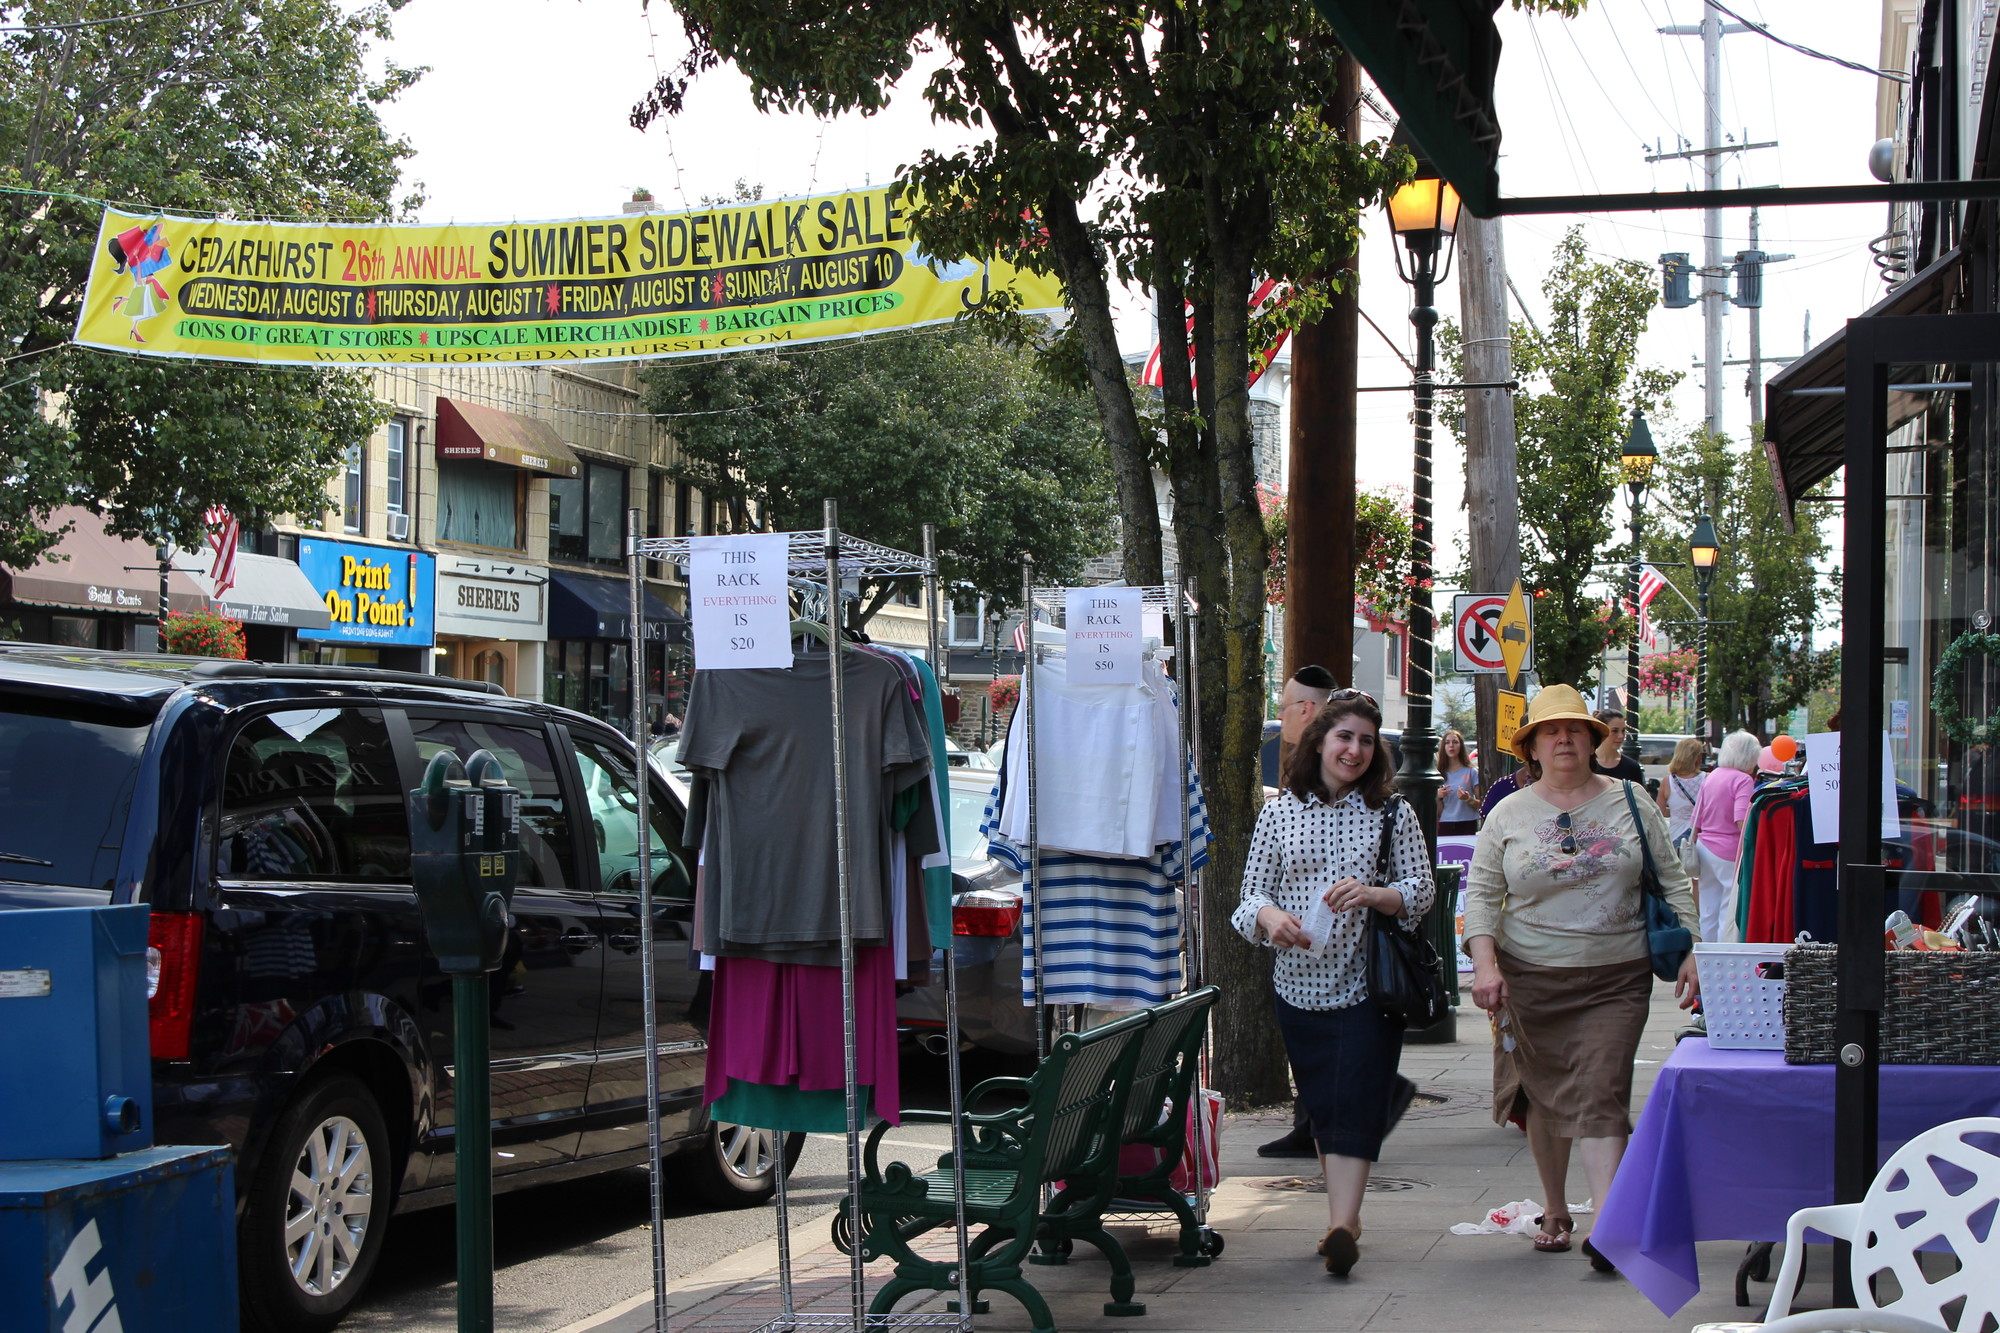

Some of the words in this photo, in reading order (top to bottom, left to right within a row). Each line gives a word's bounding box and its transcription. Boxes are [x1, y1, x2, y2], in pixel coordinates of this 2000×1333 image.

[180, 237, 334, 279] CEDARHURST
[341, 240, 385, 282] 26th
[391, 245, 481, 280] ANNUAL
[487, 223, 631, 279] SUMMER
[639, 204, 807, 271] SIDEWALK
[817, 193, 905, 251] SALE
[725, 265, 796, 299] SUNDAY,
[800, 255, 869, 291] AUGUST
[874, 253, 894, 281] 10
[187, 283, 280, 319] WEDNESDAY,
[283, 288, 352, 318] AUGUST
[355, 292, 365, 318] 6
[562, 283, 628, 314] FRIDAY,
[631, 276, 696, 309] AUGUST
[700, 276, 710, 304] 8
[376, 289, 463, 321] THURSDAY,
[466, 287, 532, 316] AUGUST
[536, 287, 544, 314] 7
[715, 304, 816, 332] BARGAIN
[818, 292, 895, 320] PRICES
[180, 321, 226, 340] TONS
[231, 325, 261, 342] OF
[266, 327, 334, 345] GREAT
[339, 330, 413, 347] STORES
[436, 328, 529, 347] UPSCALE
[535, 317, 693, 344] MERCHANDISE
[315, 330, 792, 362] WWW.SHOPCEDARHURST.COM
[721, 551, 756, 564] THIS
[342, 555, 391, 590] Print
[717, 573, 760, 587] RACK
[326, 589, 352, 622] On
[458, 585, 520, 612] SHEREL'S
[703, 595, 777, 607] EVERYTHING
[1090, 598, 1118, 609] THIS
[251, 606, 268, 621] Hair
[269, 607, 290, 623] Salon
[734, 613, 748, 626] IS
[1087, 615, 1121, 625] RACK
[730, 637, 755, 650] $20
[1075, 631, 1133, 639] EVERYTHING
[1099, 643, 1110, 653] IS
[1094, 661, 1114, 670] $50
[1505, 704, 1516, 721] FIRE
[1825, 780, 1841, 791] 50
